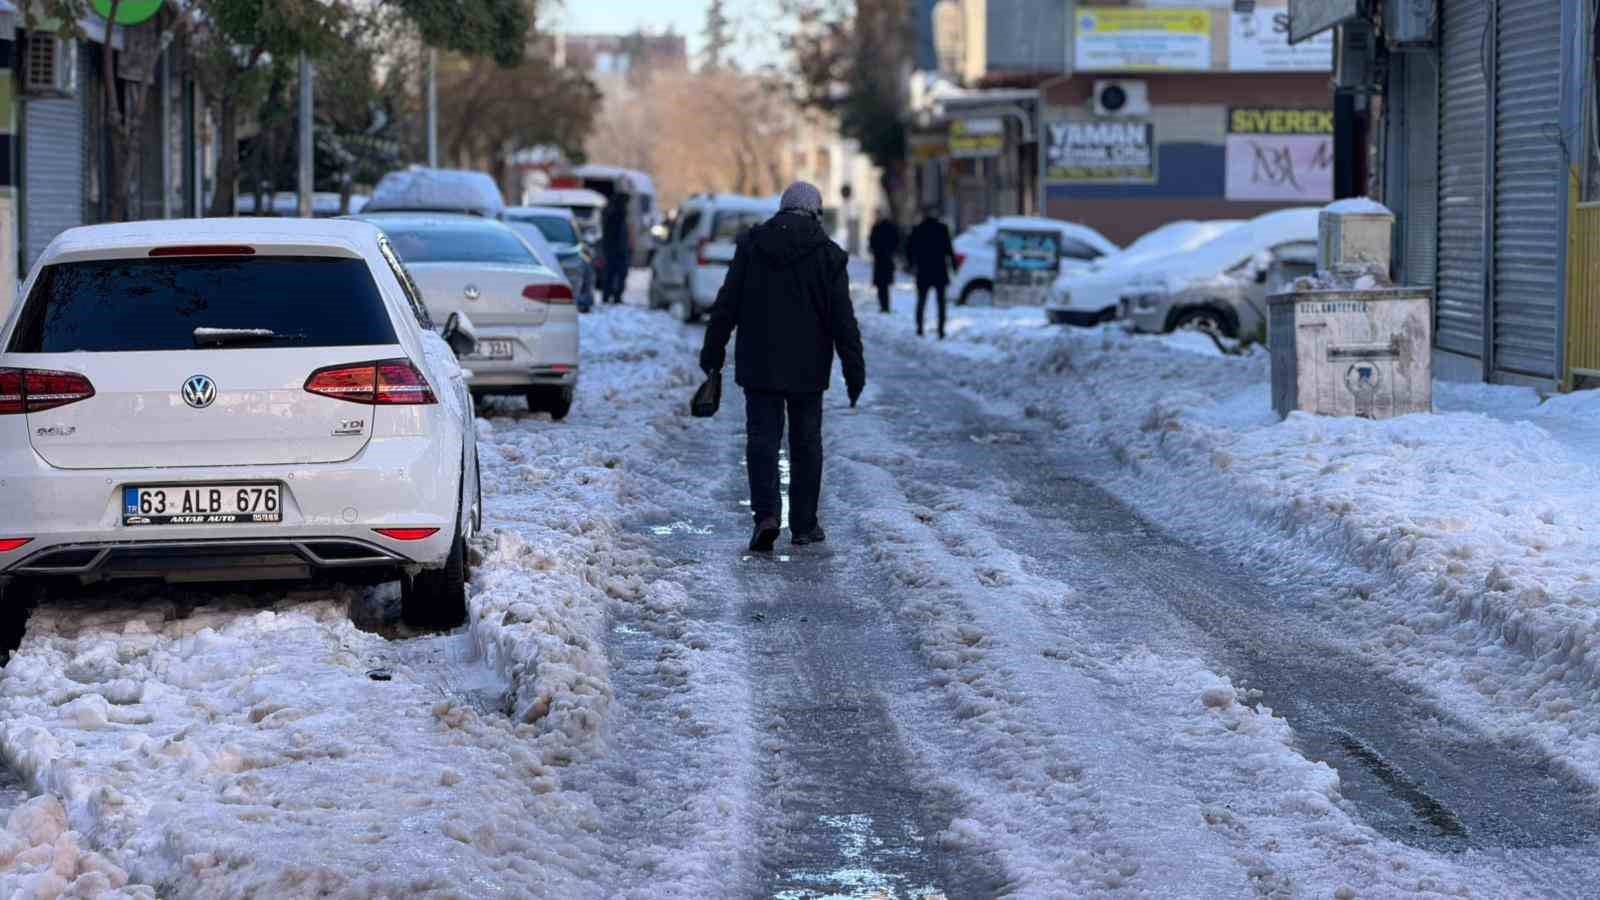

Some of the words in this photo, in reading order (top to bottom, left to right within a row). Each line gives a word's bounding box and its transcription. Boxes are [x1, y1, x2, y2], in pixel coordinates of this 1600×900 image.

[1049, 122, 1145, 145] YAMAN
[140, 490, 167, 514] 63
[182, 488, 221, 513] ALB
[236, 488, 277, 512] 676
[169, 515, 206, 523] AKTAR
